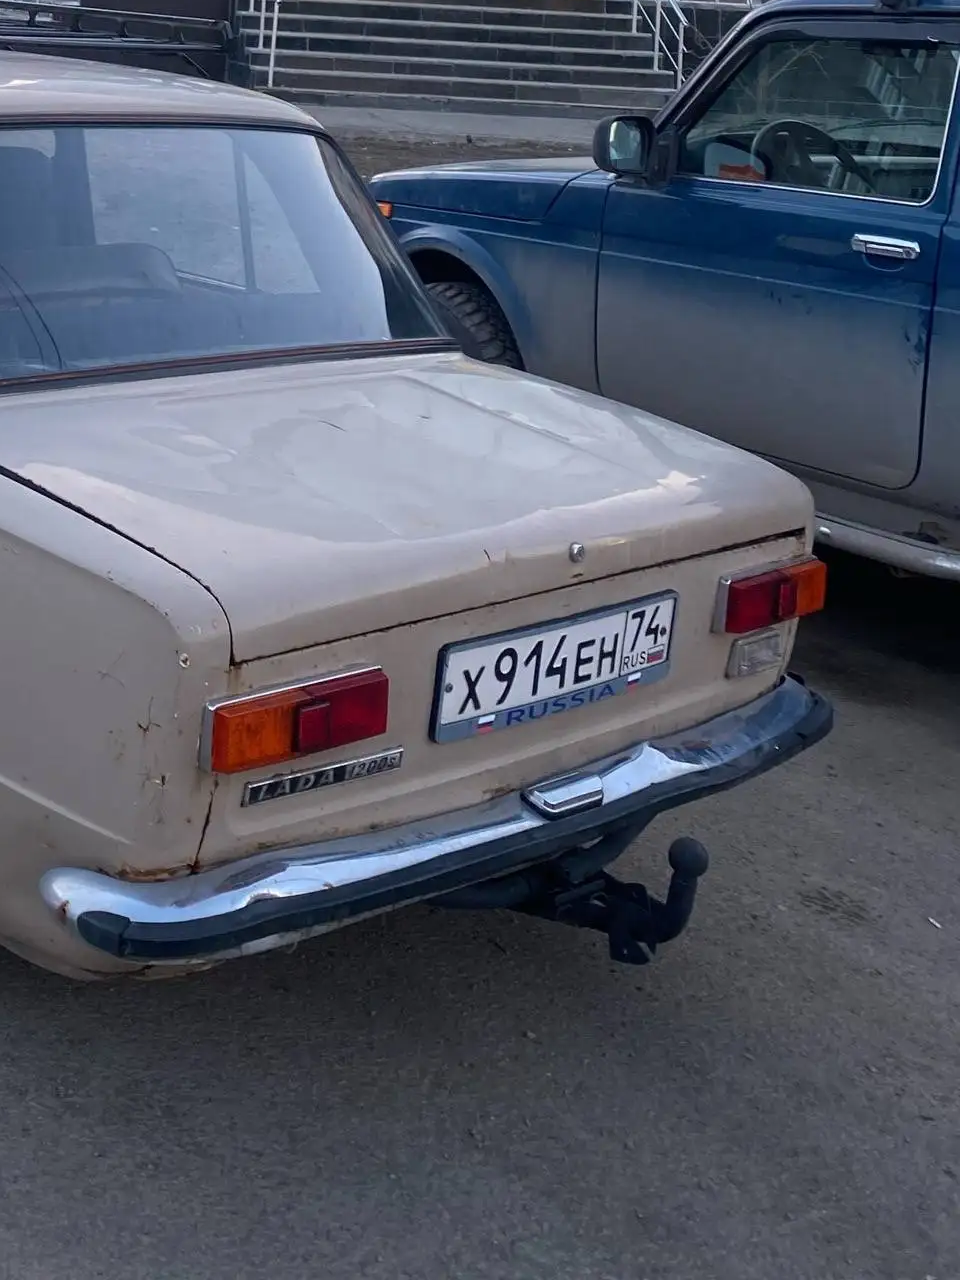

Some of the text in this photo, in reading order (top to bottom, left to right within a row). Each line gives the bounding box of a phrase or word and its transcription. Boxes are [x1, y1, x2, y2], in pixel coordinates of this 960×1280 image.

[457, 605, 662, 715] Х914ЕН 74
[622, 650, 647, 672] RUS
[506, 684, 617, 726] RUSSIA
[257, 769, 335, 801] LADA
